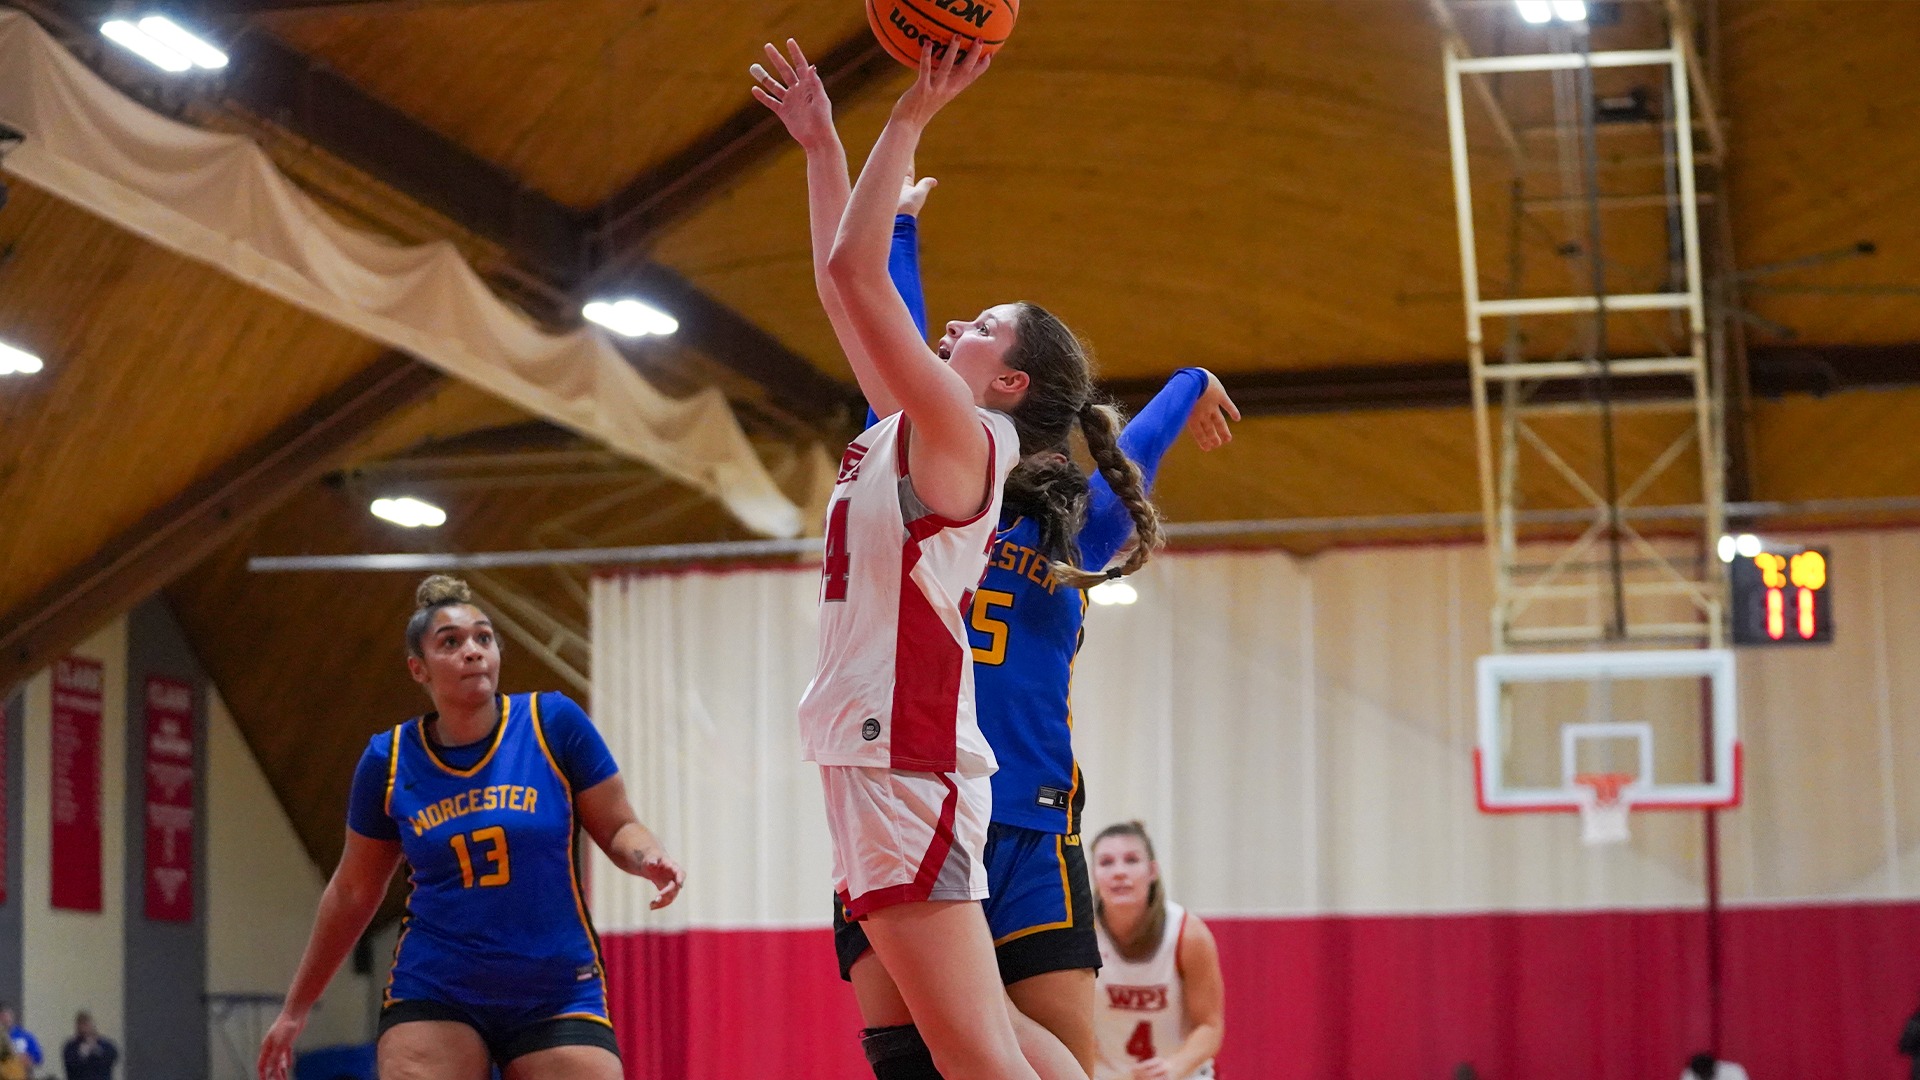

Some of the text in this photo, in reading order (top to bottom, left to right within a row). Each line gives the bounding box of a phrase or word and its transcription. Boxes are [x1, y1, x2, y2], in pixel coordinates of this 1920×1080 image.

[1765, 587, 1816, 640] 11
[408, 784, 538, 837] WORCESTER
[450, 825, 510, 889] 13
[1104, 984, 1169, 1013] WPI
[1124, 1020, 1157, 1064] 4
